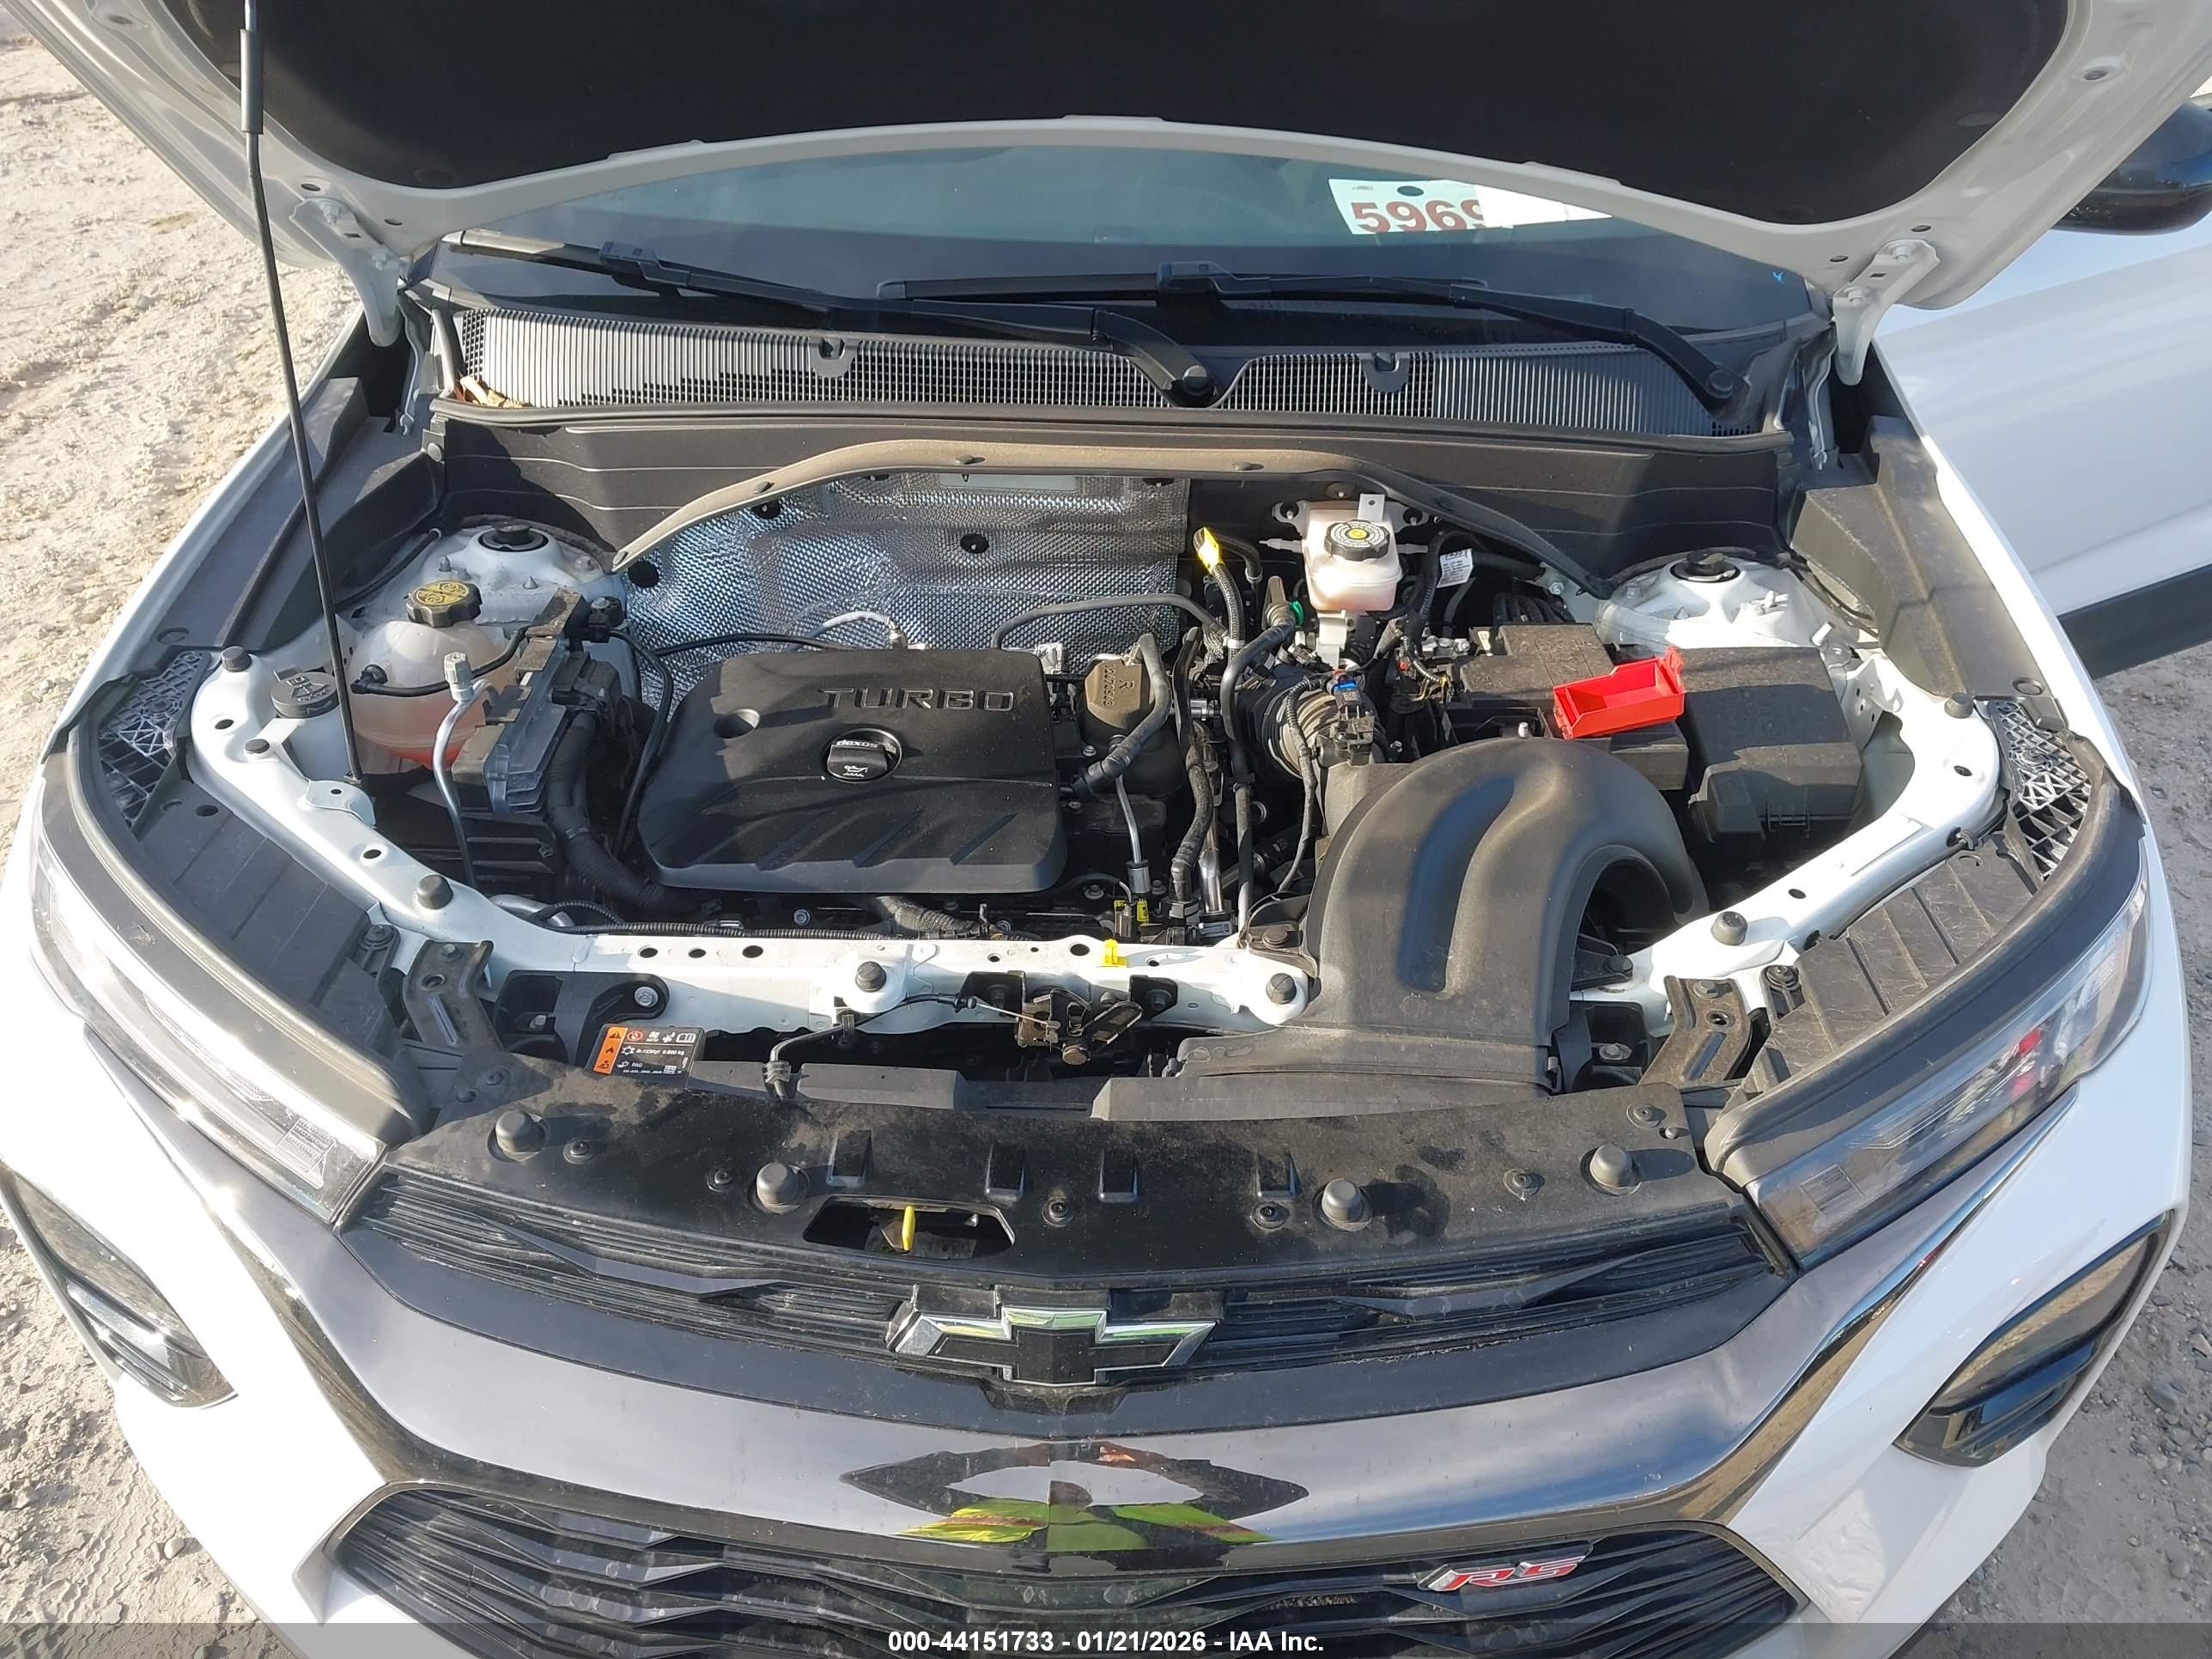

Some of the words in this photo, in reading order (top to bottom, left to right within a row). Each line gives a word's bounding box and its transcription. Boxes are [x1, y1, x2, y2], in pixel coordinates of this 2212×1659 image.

[818, 687, 1015, 712] TURBO
[836, 739, 879, 749] dexos
[1427, 1555, 1586, 1592] RS
